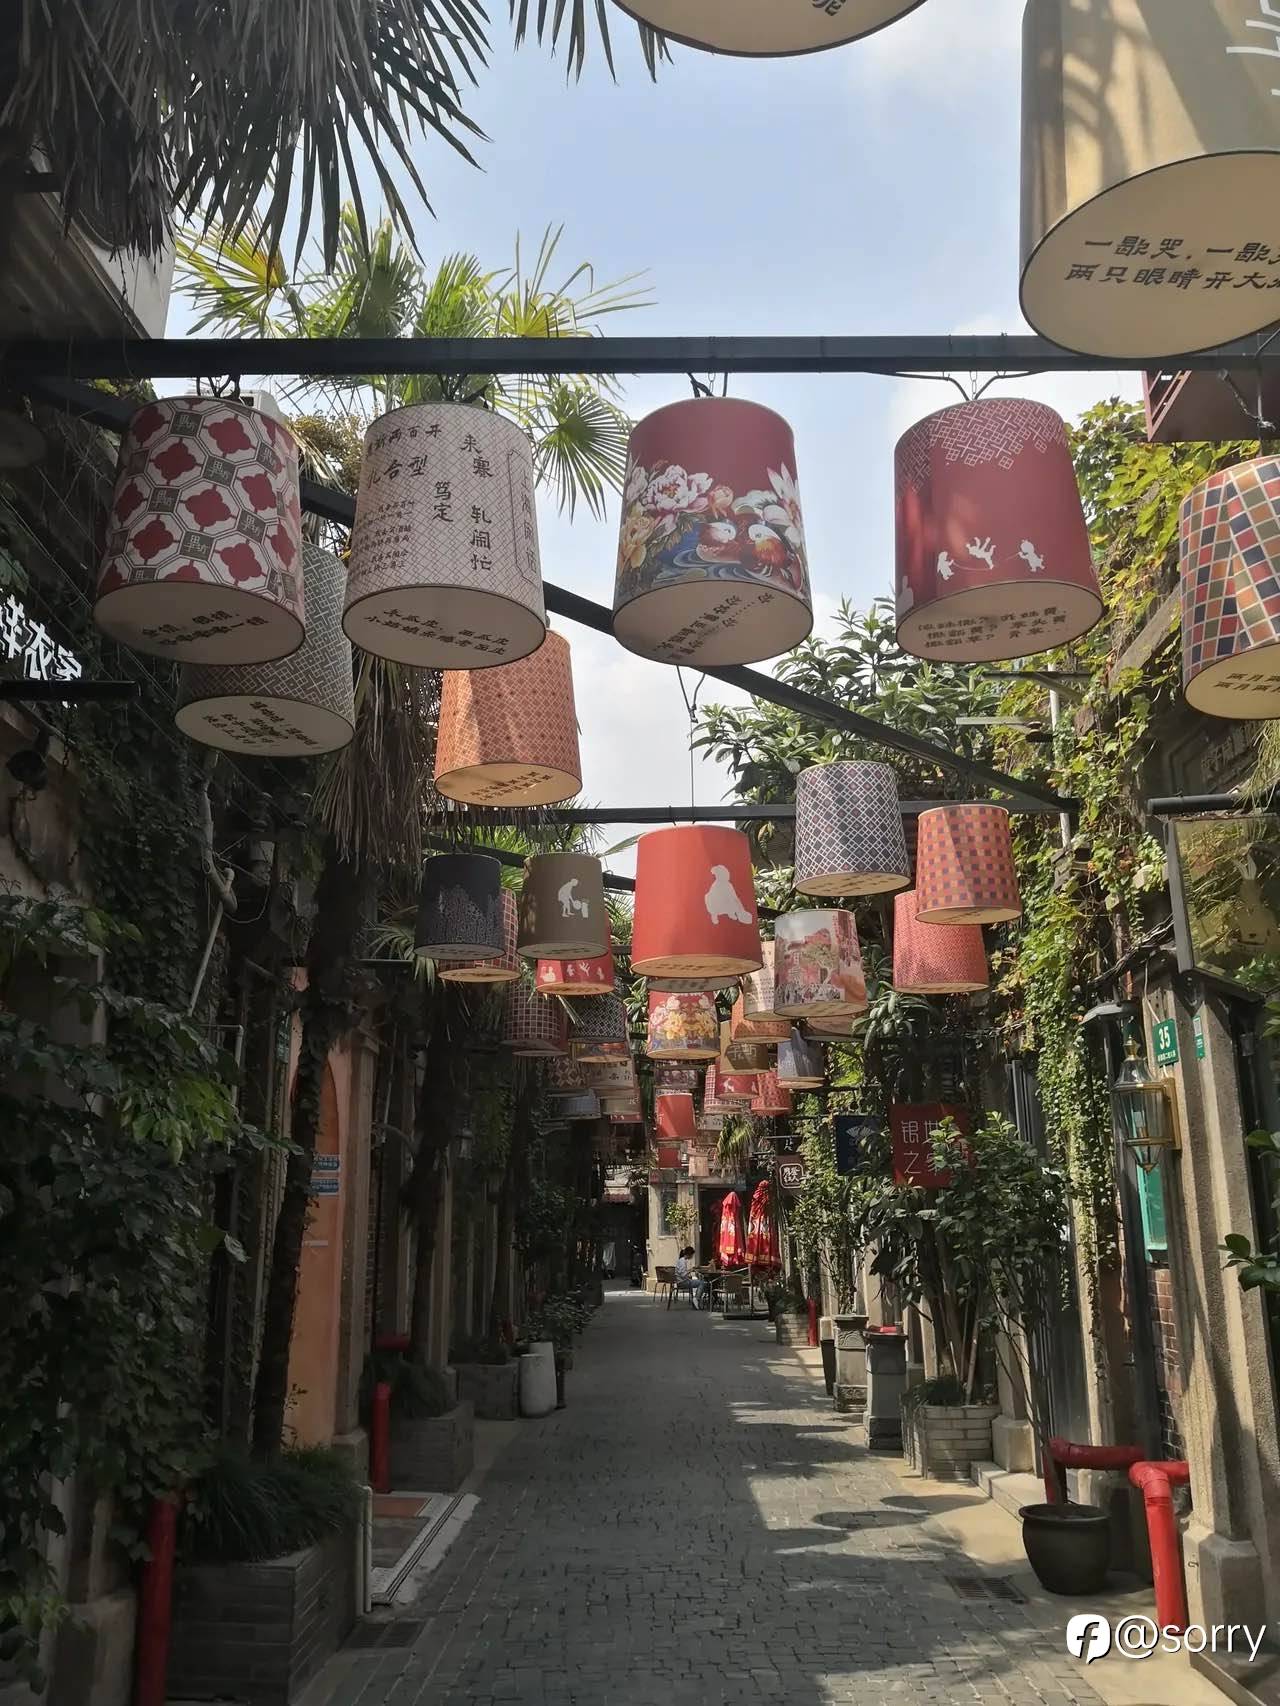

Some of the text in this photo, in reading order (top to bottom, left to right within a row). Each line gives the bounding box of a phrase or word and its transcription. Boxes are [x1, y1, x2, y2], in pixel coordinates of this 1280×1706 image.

[432, 480, 453, 523] 笃定
[470, 504, 493, 571] 轧闹忙
[1158, 1026, 1171, 1050] 35
